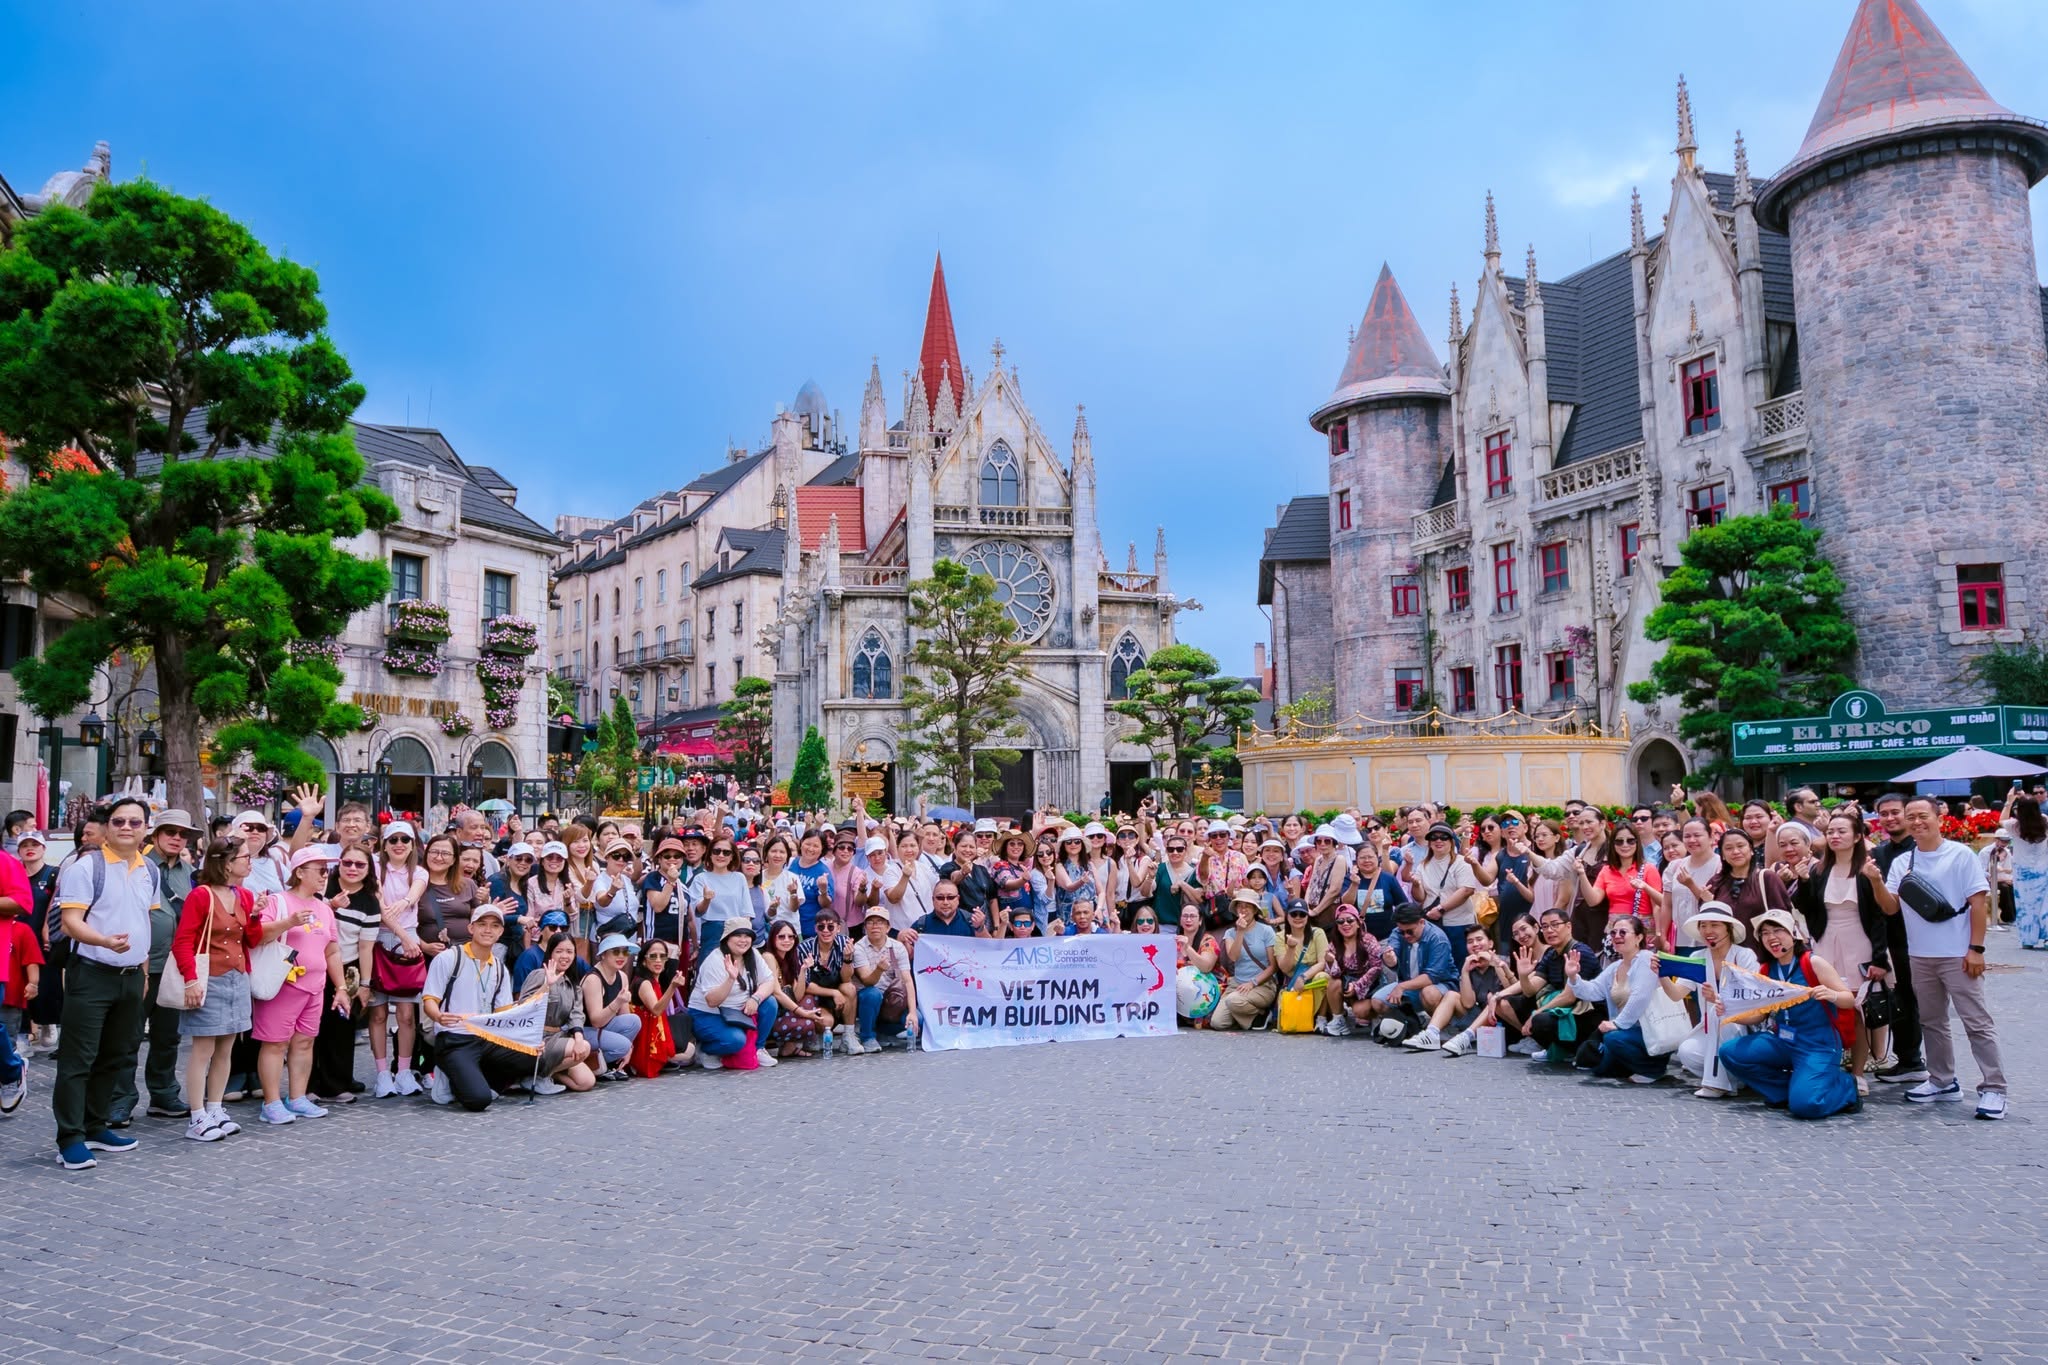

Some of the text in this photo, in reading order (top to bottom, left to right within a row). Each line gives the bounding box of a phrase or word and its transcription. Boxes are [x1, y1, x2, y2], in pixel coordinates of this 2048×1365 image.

[1791, 719, 1931, 740] EL FRESCO
[1764, 744, 1787, 753] JUICE
[1794, 741, 1841, 752] SMOOTHIES
[1849, 740, 1873, 749] FRUIT
[1881, 738, 1905, 748] CAFE
[1913, 737, 1928, 746] ICE
[1931, 735, 1965, 745] CREAM
[1001, 946, 1053, 965] AMSI
[1053, 948, 1078, 956] Group
[1054, 955, 1098, 963] Companies
[999, 979, 1099, 1001] VIETNAM
[1733, 988, 1763, 1000] BUS
[485, 1017, 534, 1029] BUS 05
[933, 1001, 1160, 1027] TEAM BUILDING TRIP
